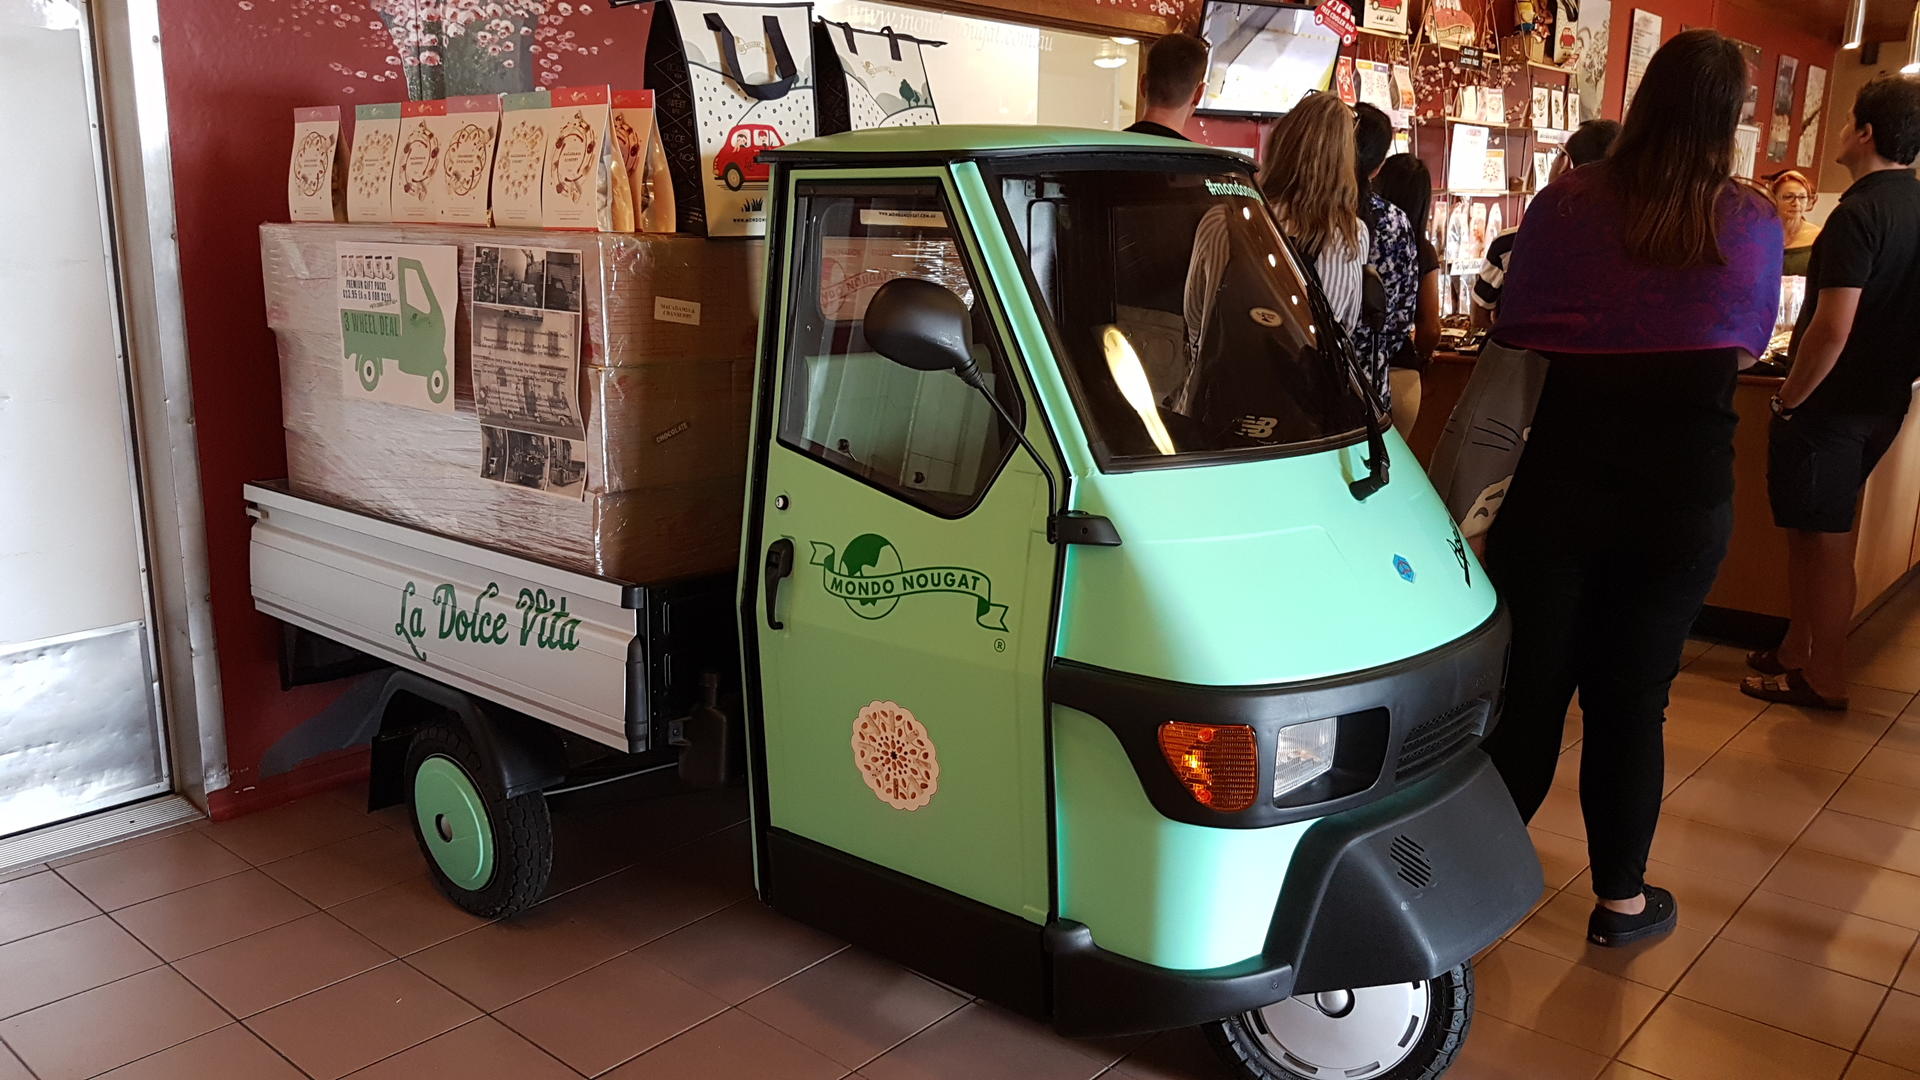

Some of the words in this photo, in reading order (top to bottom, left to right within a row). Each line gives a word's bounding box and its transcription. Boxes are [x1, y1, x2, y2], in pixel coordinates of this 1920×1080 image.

[847, 4, 1054, 51] www.mondougat.com.au
[1321, 5, 1331, 16] FREE
[1330, 12, 1346, 27] COOLER
[364, 280, 373, 290] GIFT
[374, 281, 387, 291] PACKS
[344, 312, 350, 332] 3
[351, 312, 378, 336] WHEEL
[380, 315, 399, 337] DEAL
[829, 577, 895, 597] MONDO
[901, 572, 981, 592] NOUGAT
[395, 581, 427, 662] La
[433, 581, 509, 646] Dolce
[515, 587, 582, 651] Vita
